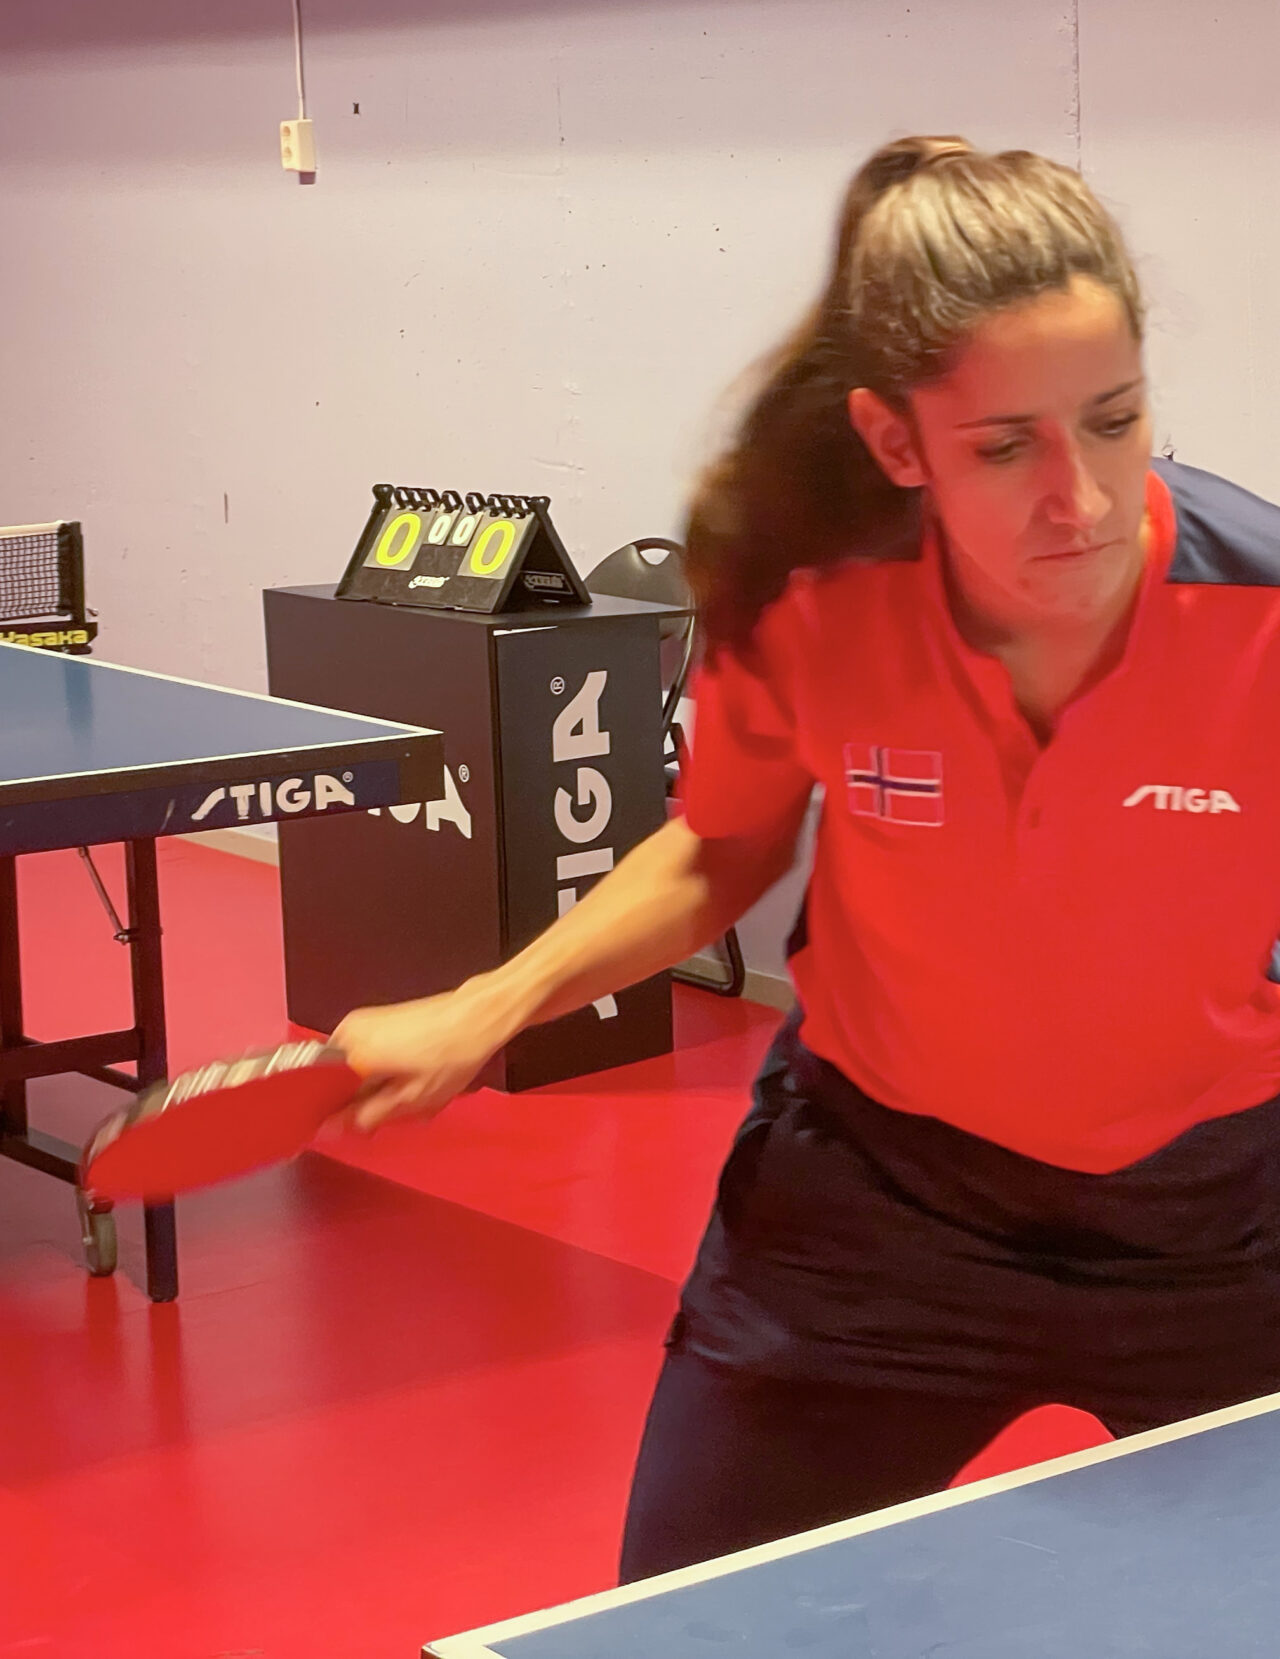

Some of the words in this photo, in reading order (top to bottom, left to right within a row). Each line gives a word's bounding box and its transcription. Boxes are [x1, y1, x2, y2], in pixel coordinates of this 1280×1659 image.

[376, 513, 421, 566] 0
[428, 515, 451, 544] 0
[452, 516, 476, 545] 0
[470, 520, 516, 575] 0
[191, 774, 355, 821] STIGA
[1122, 784, 1241, 814] STIGA
[553, 670, 618, 1020] IGA
